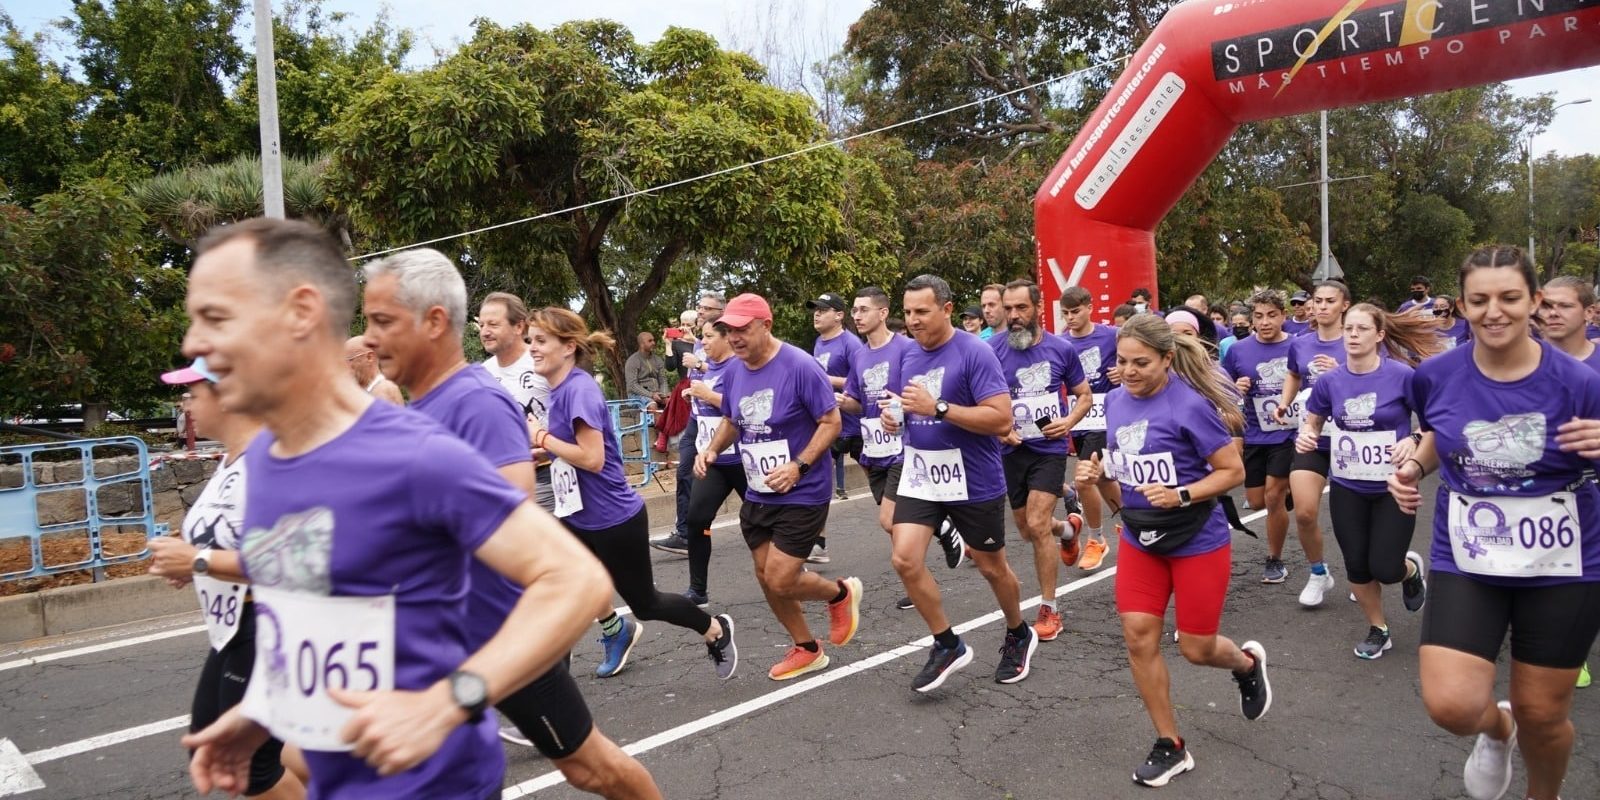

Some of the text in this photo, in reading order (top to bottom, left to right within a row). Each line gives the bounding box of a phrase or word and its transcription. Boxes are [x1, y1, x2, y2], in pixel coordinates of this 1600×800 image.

[1229, 16, 1600, 94] MÁS TIEMPO PAR
[1362, 445, 1392, 465] 035
[931, 463, 962, 484] 004
[1133, 459, 1170, 484] 020
[1519, 515, 1574, 549] 086
[298, 639, 379, 698] 065
